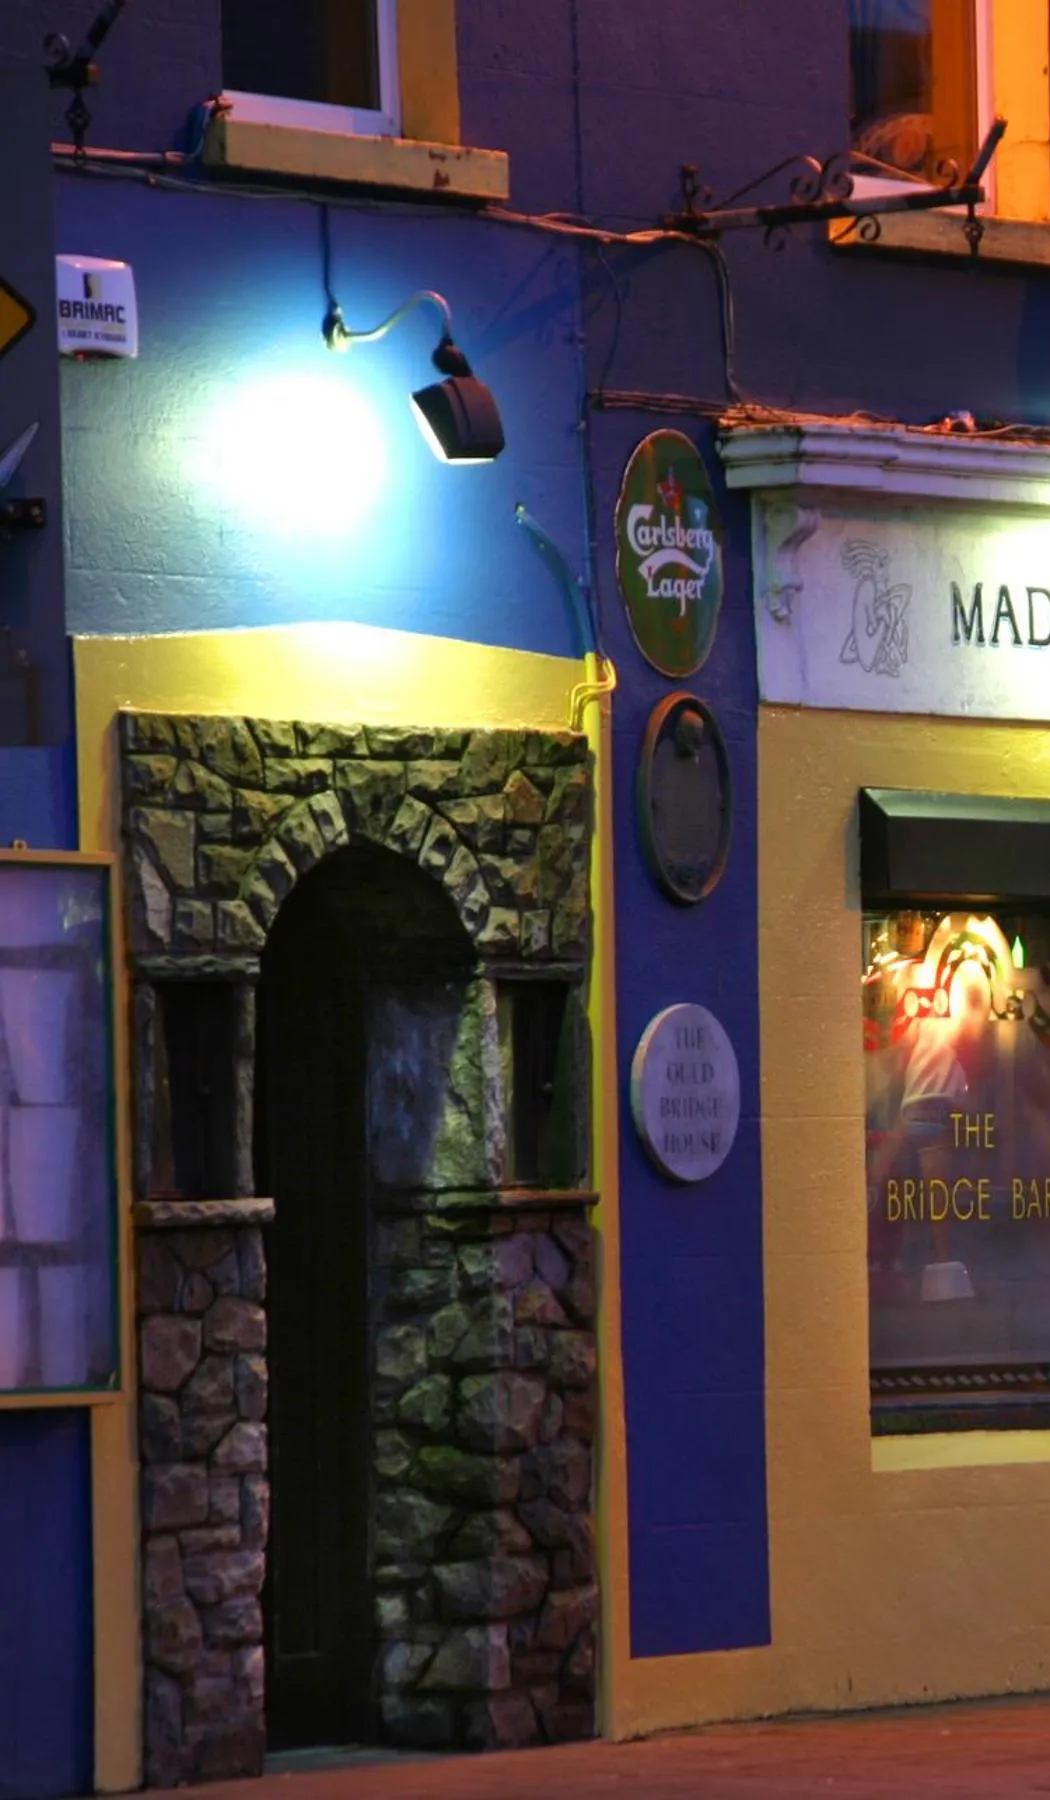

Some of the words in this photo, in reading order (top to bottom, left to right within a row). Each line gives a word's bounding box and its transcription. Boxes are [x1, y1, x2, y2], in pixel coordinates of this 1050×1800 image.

[59, 299, 126, 323] BRIMAC
[626, 504, 714, 556] Carlsberg
[646, 572, 706, 618] Lager
[950, 1113, 995, 1149] THE
[886, 1179, 992, 1222] BRIDGE
